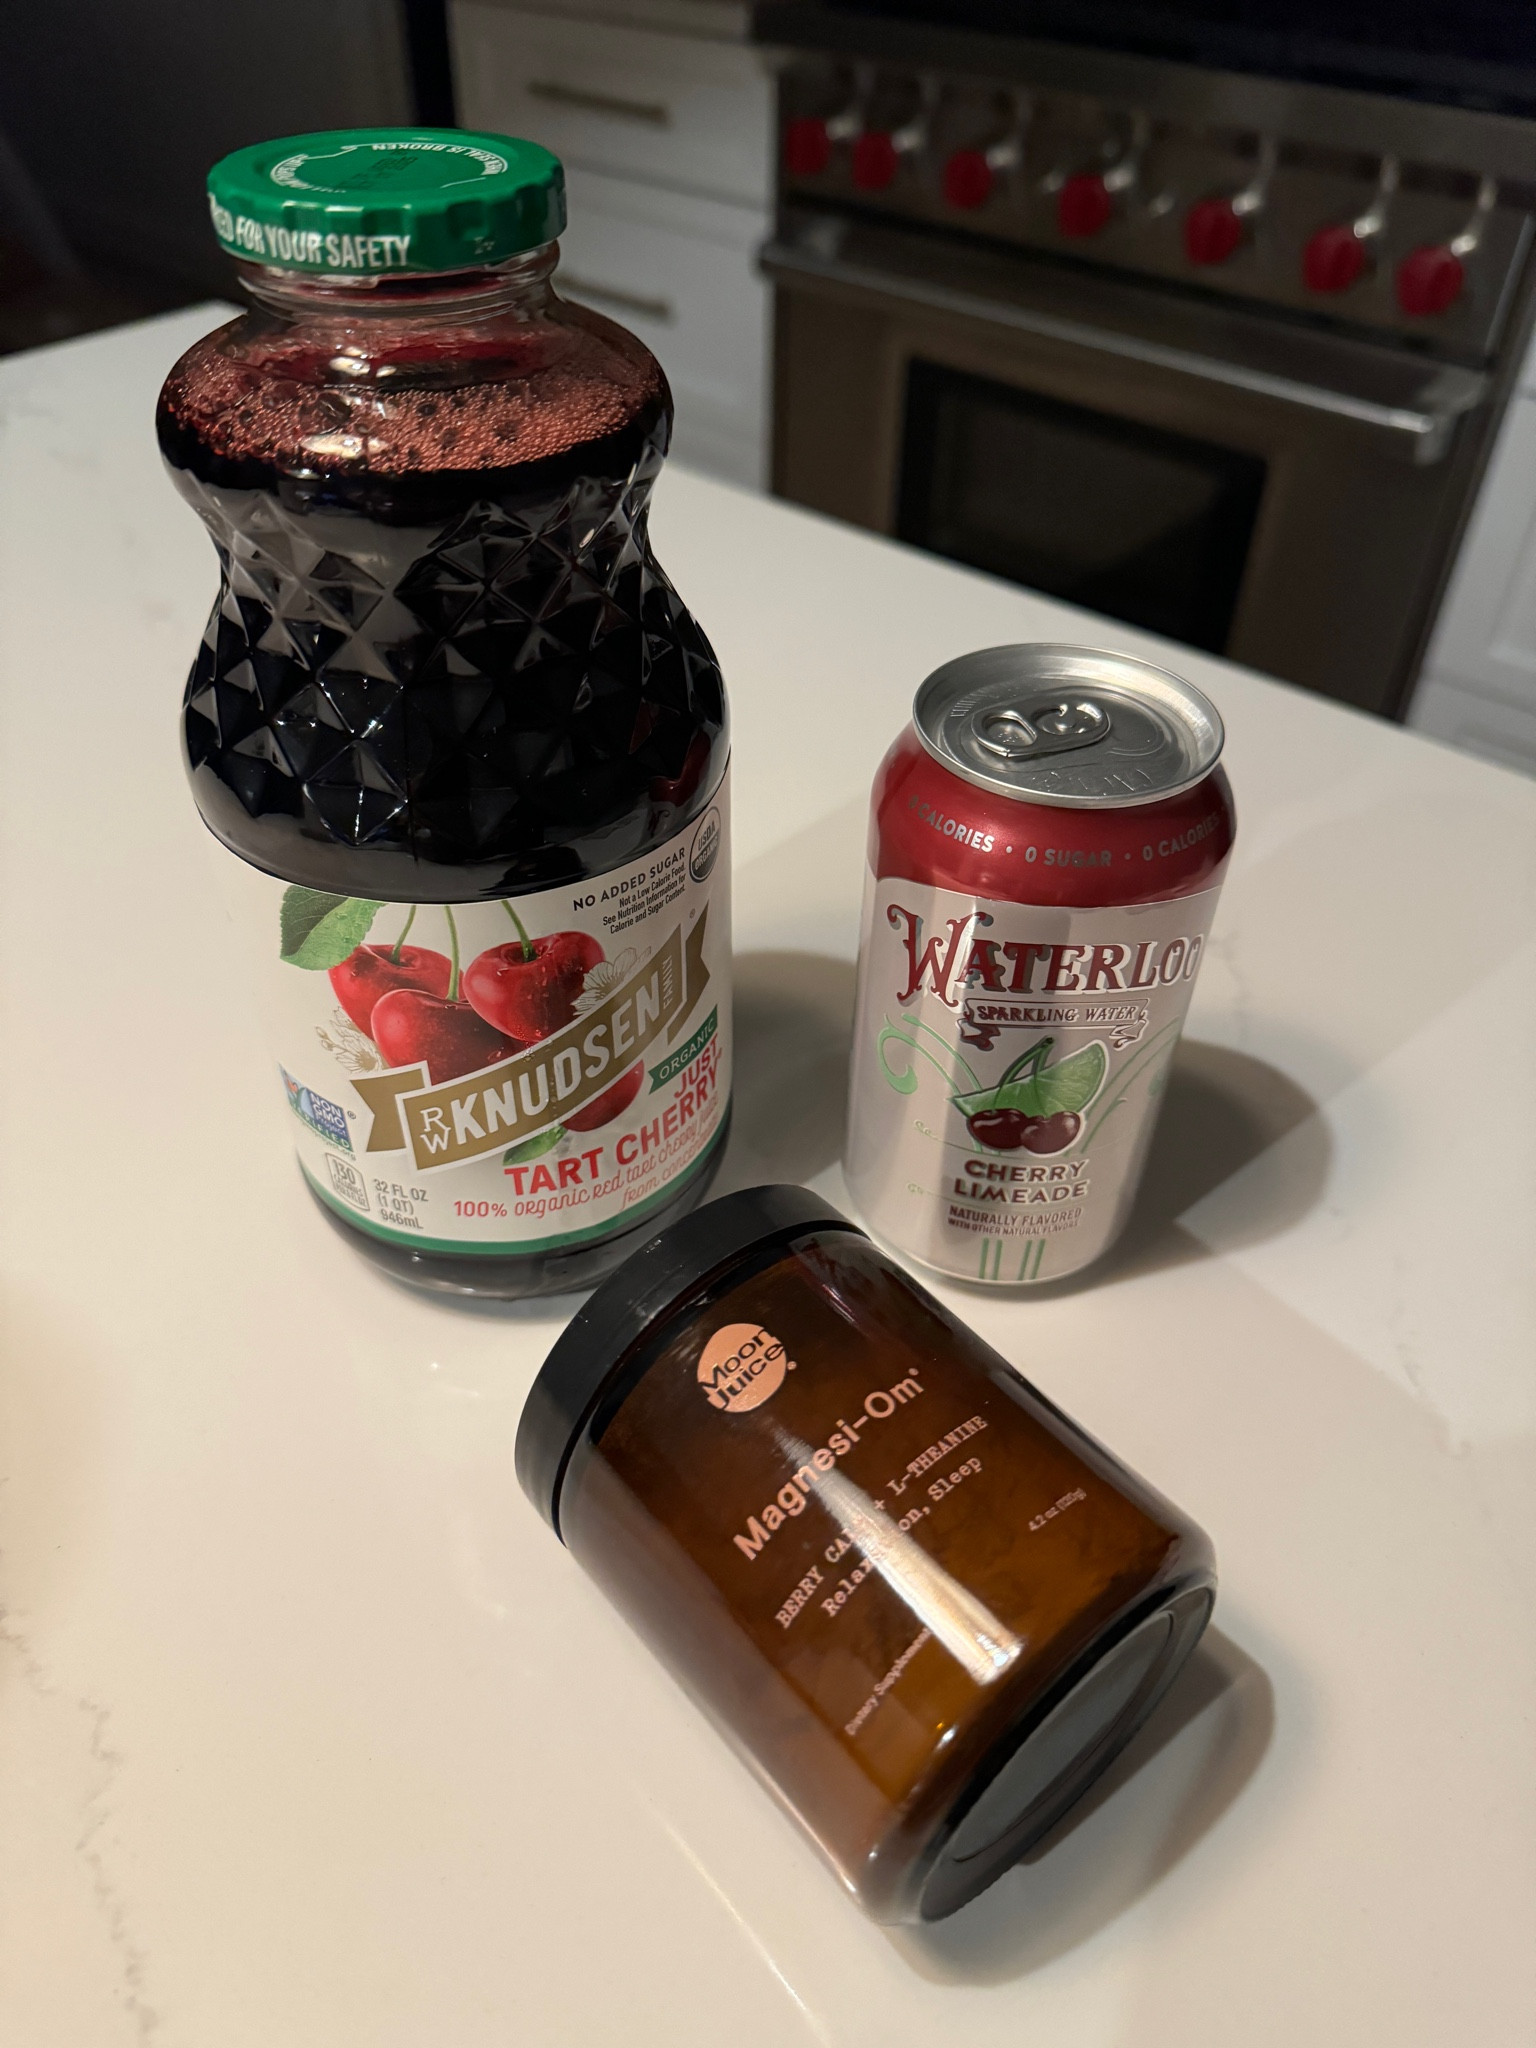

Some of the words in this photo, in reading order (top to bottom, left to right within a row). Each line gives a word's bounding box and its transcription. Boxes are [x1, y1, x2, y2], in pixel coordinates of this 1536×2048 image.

[236, 214, 265, 254] FOR
[264, 224, 322, 264] YOUR
[325, 233, 411, 268] SAFETY
[698, 820, 715, 851] USDA
[917, 803, 996, 853] CALORIES
[1025, 846, 1037, 863] 0
[1044, 848, 1112, 868] SUGAR
[1142, 845, 1153, 861] 0
[1158, 811, 1220, 857] CALORIES
[573, 894, 596, 912] NO
[601, 872, 646, 903] ADDED
[649, 847, 686, 879] SUGAR
[602, 915, 616, 926] See
[617, 900, 645, 920] Nutrition
[646, 880, 678, 905] Information
[678, 873, 686, 885] for
[619, 896, 631, 909] Not
[637, 886, 650, 900] Low
[651, 873, 671, 891] Calorie
[610, 916, 634, 934] Calorie
[635, 910, 647, 923] and
[647, 900, 664, 916] Sugar
[887, 904, 1205, 1007] WATERLOO
[977, 1004, 1078, 1022] SPARKLING
[1085, 1004, 1138, 1021] WATER
[450, 970, 661, 1145] KNUDSEN
[662, 954, 673, 1010] FAMILY
[659, 1017, 715, 1080] ORGANIC
[674, 1033, 719, 1099] JUST
[309, 1091, 343, 1118] NON
[312, 1102, 345, 1129] GMO
[504, 1146, 604, 1197] TART
[616, 1047, 723, 1165] CHERRY
[332, 1158, 356, 1186] 130
[373, 1178, 389, 1195] 32
[391, 1183, 408, 1199] FL
[410, 1187, 429, 1203] OZ
[453, 1200, 508, 1218] 100%
[514, 1187, 591, 1219] organic
[626, 1154, 656, 1183] tart
[953, 1178, 1089, 1204] LIMEADE
[964, 1158, 1089, 1183] CHERRY
[377, 1192, 389, 1208] (1
[392, 1197, 415, 1216] QT)
[619, 1176, 659, 1211] from
[380, 1207, 424, 1230] 946mL
[947, 1217, 971, 1230] WITH
[971, 1222, 1001, 1235] OTHER
[1002, 1225, 1041, 1236] NATURAL
[1042, 1219, 1079, 1235] FLAVORS
[949, 1204, 1019, 1226] NATURALLY
[1021, 1206, 1083, 1227] FLAVORED
[700, 1327, 776, 1396] Moon
[714, 1342, 785, 1410] Juice
[733, 1375, 925, 1561] Magnesi-Om
[927, 1455, 984, 1503] Sleep
[775, 1564, 825, 1629] BERRY
[885, 1414, 990, 1497] L-THEANINE
